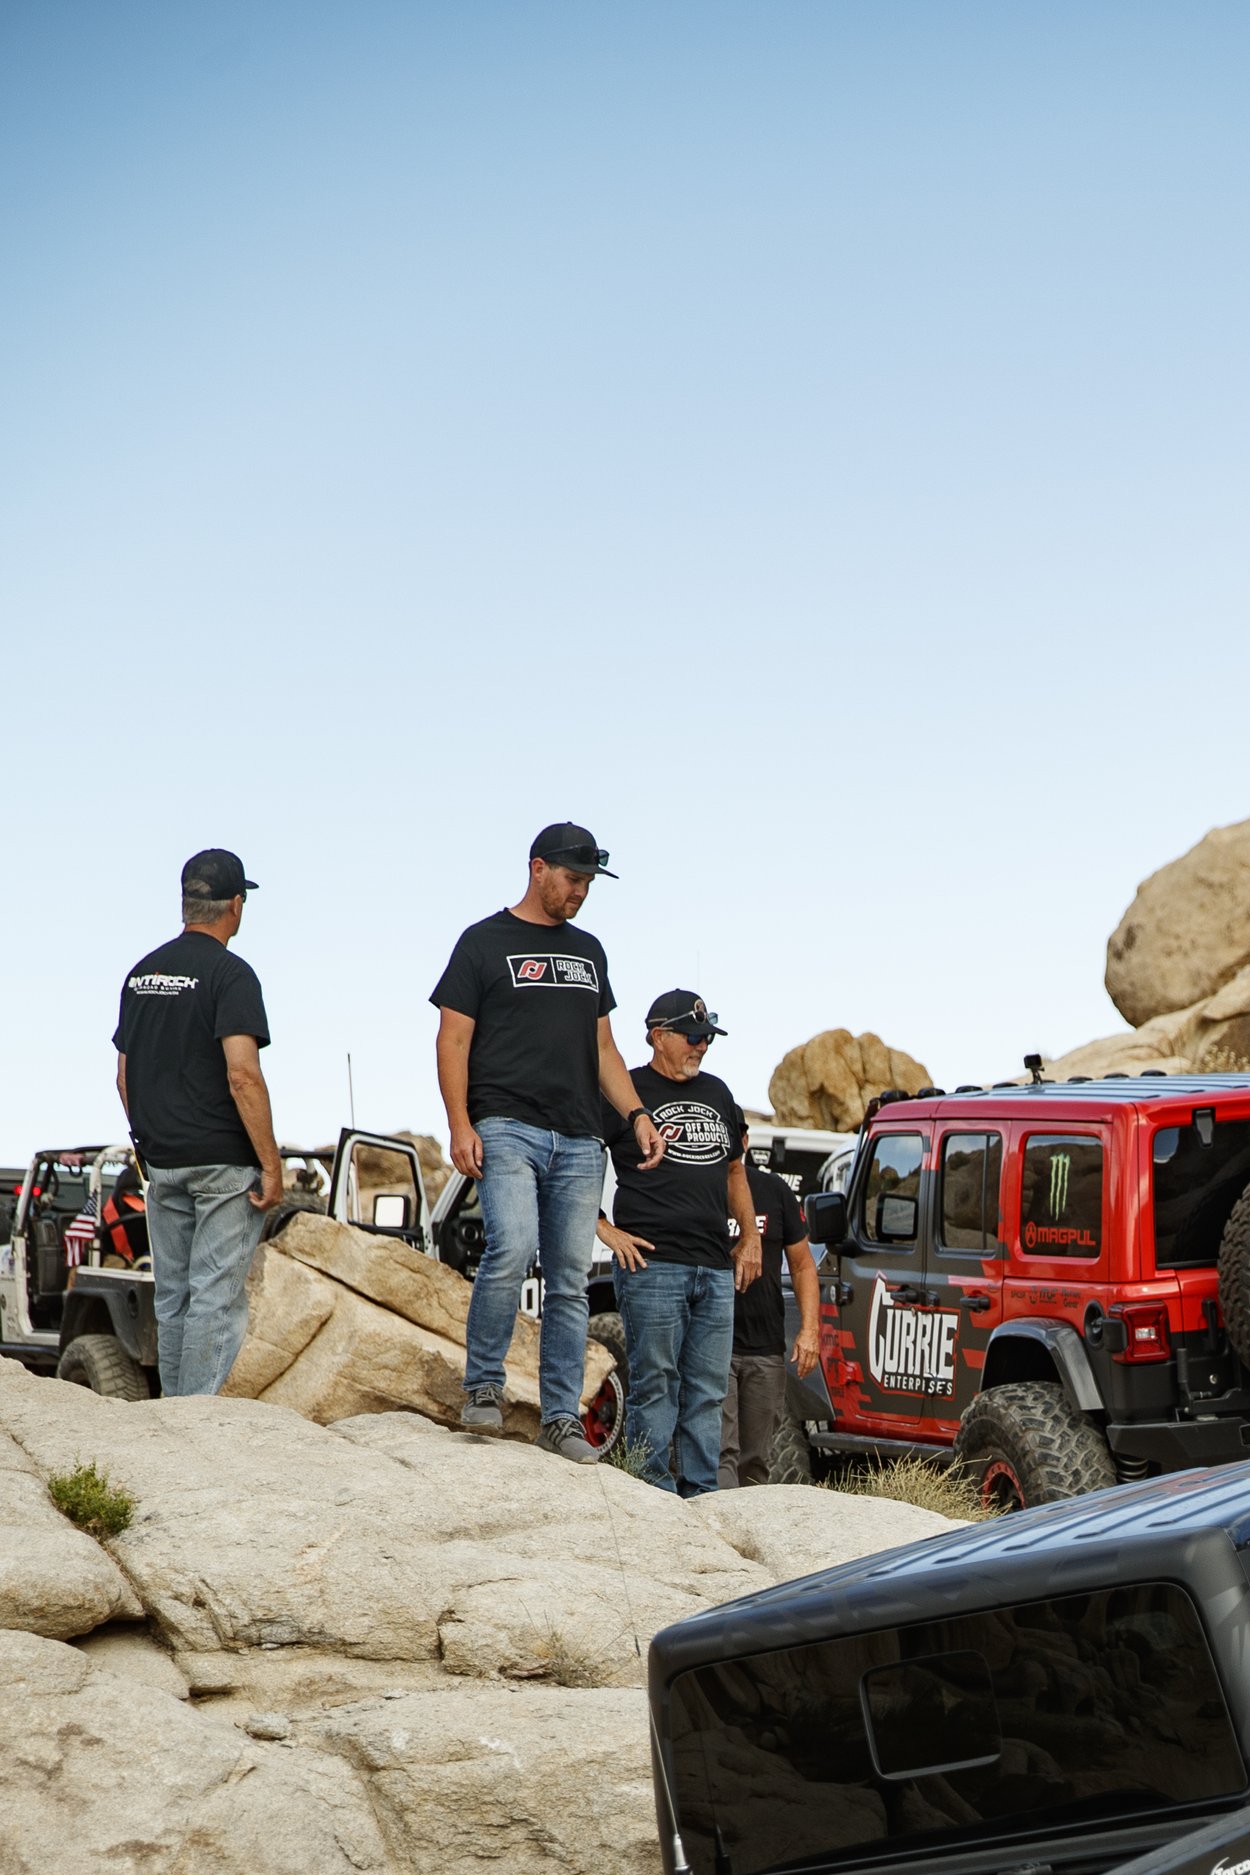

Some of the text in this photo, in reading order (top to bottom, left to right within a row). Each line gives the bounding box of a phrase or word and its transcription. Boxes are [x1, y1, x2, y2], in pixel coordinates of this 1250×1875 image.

[659, 1105, 713, 1120] ROCK JOCK
[685, 1122, 726, 1134] OFF ROAD
[686, 1131, 728, 1143] PRODUCTS
[1037, 1227, 1096, 1246] MAGPUL
[868, 1277, 959, 1384] CURRIE
